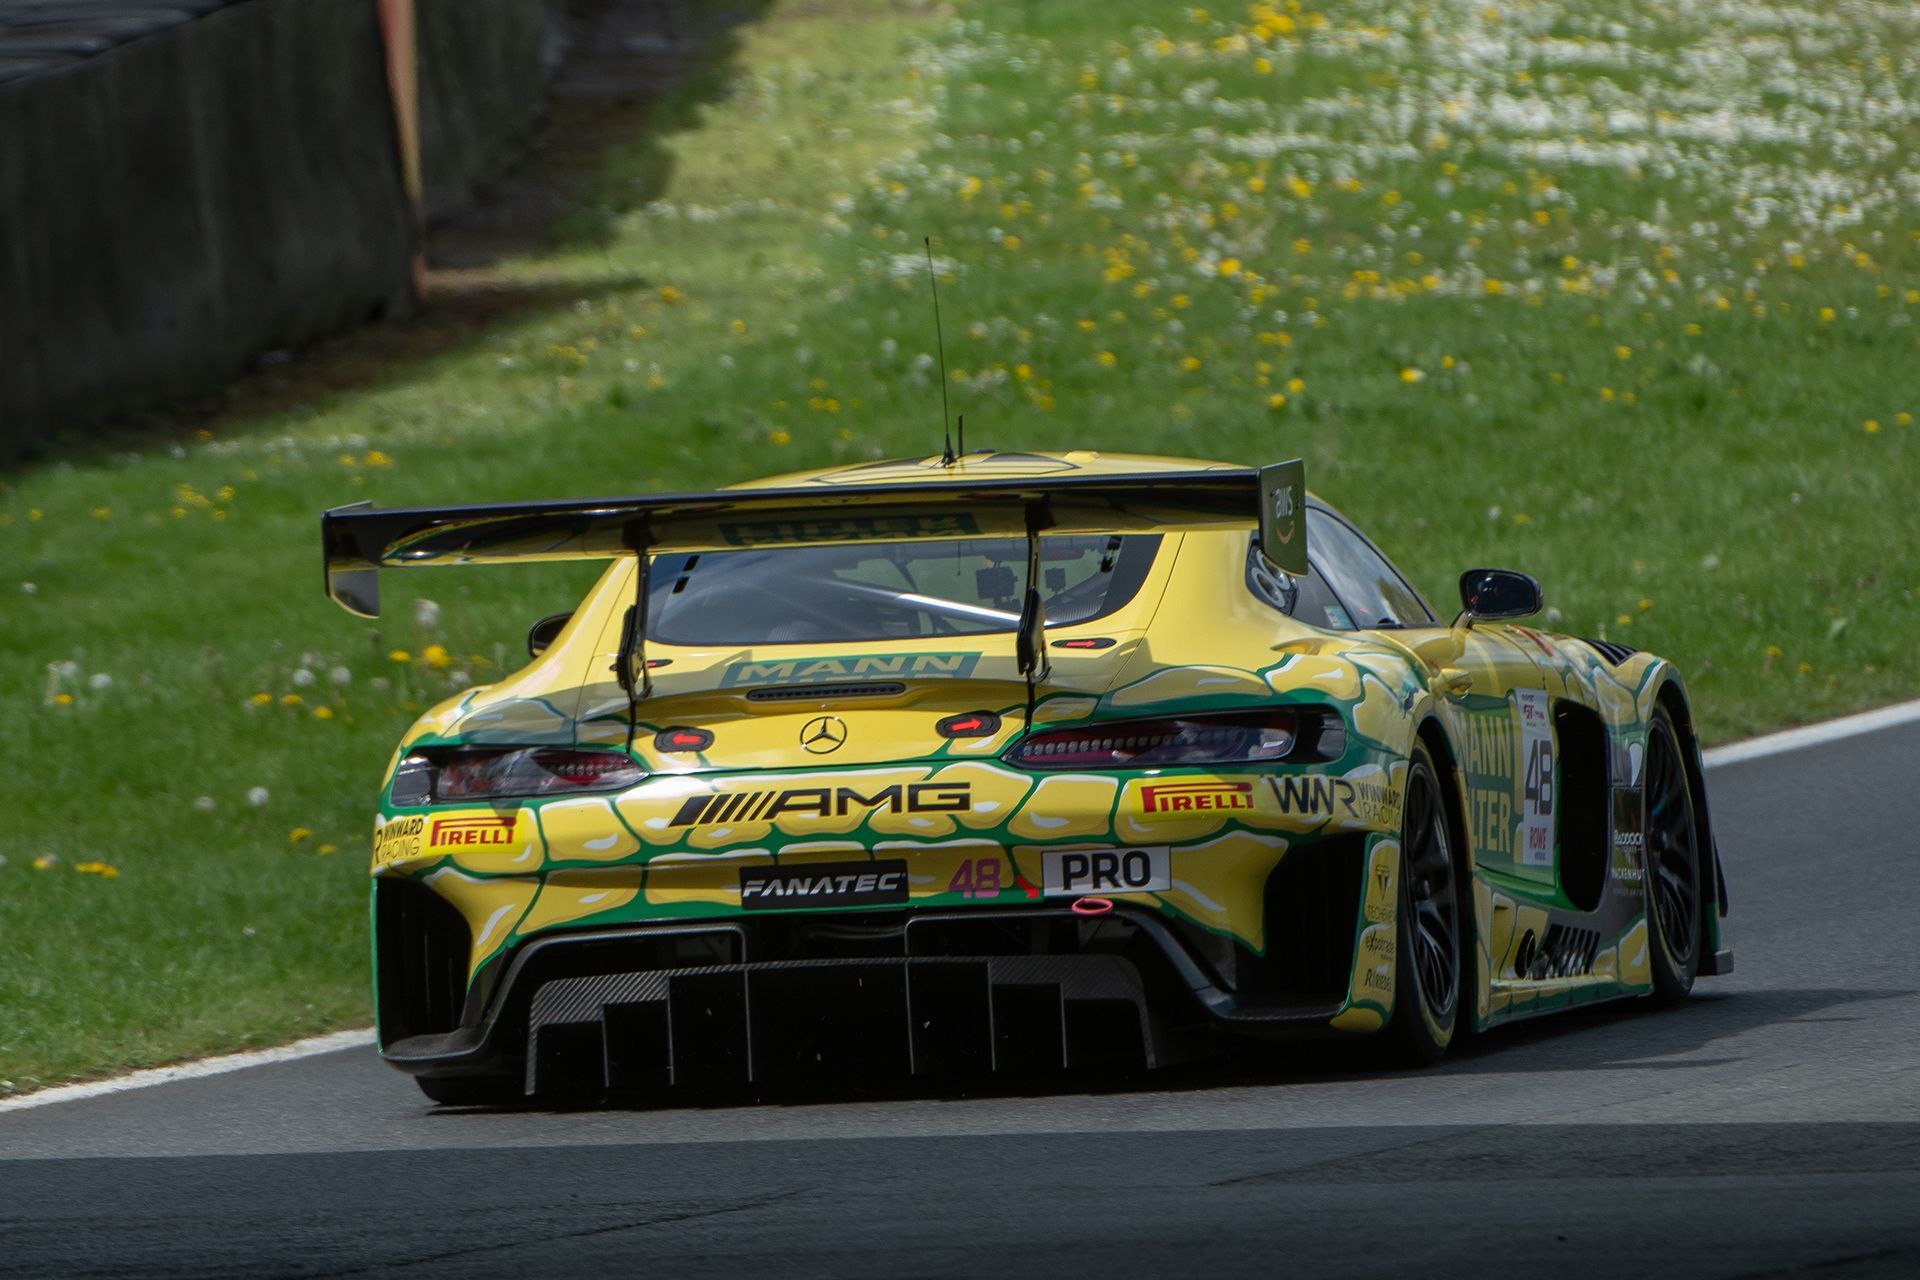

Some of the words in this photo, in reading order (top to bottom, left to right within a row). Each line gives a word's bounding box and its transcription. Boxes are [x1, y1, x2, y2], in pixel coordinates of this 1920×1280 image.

[1275, 486, 1293, 518] aws
[736, 655, 964, 681] MANN
[1525, 739, 1553, 816] 48
[761, 782, 971, 820] AMG
[1141, 782, 1255, 813] PIRELLI
[430, 817, 516, 847] PIRELLI
[742, 872, 902, 898] FANATEC
[949, 858, 1000, 898] 48
[1062, 850, 1151, 891] PRO
